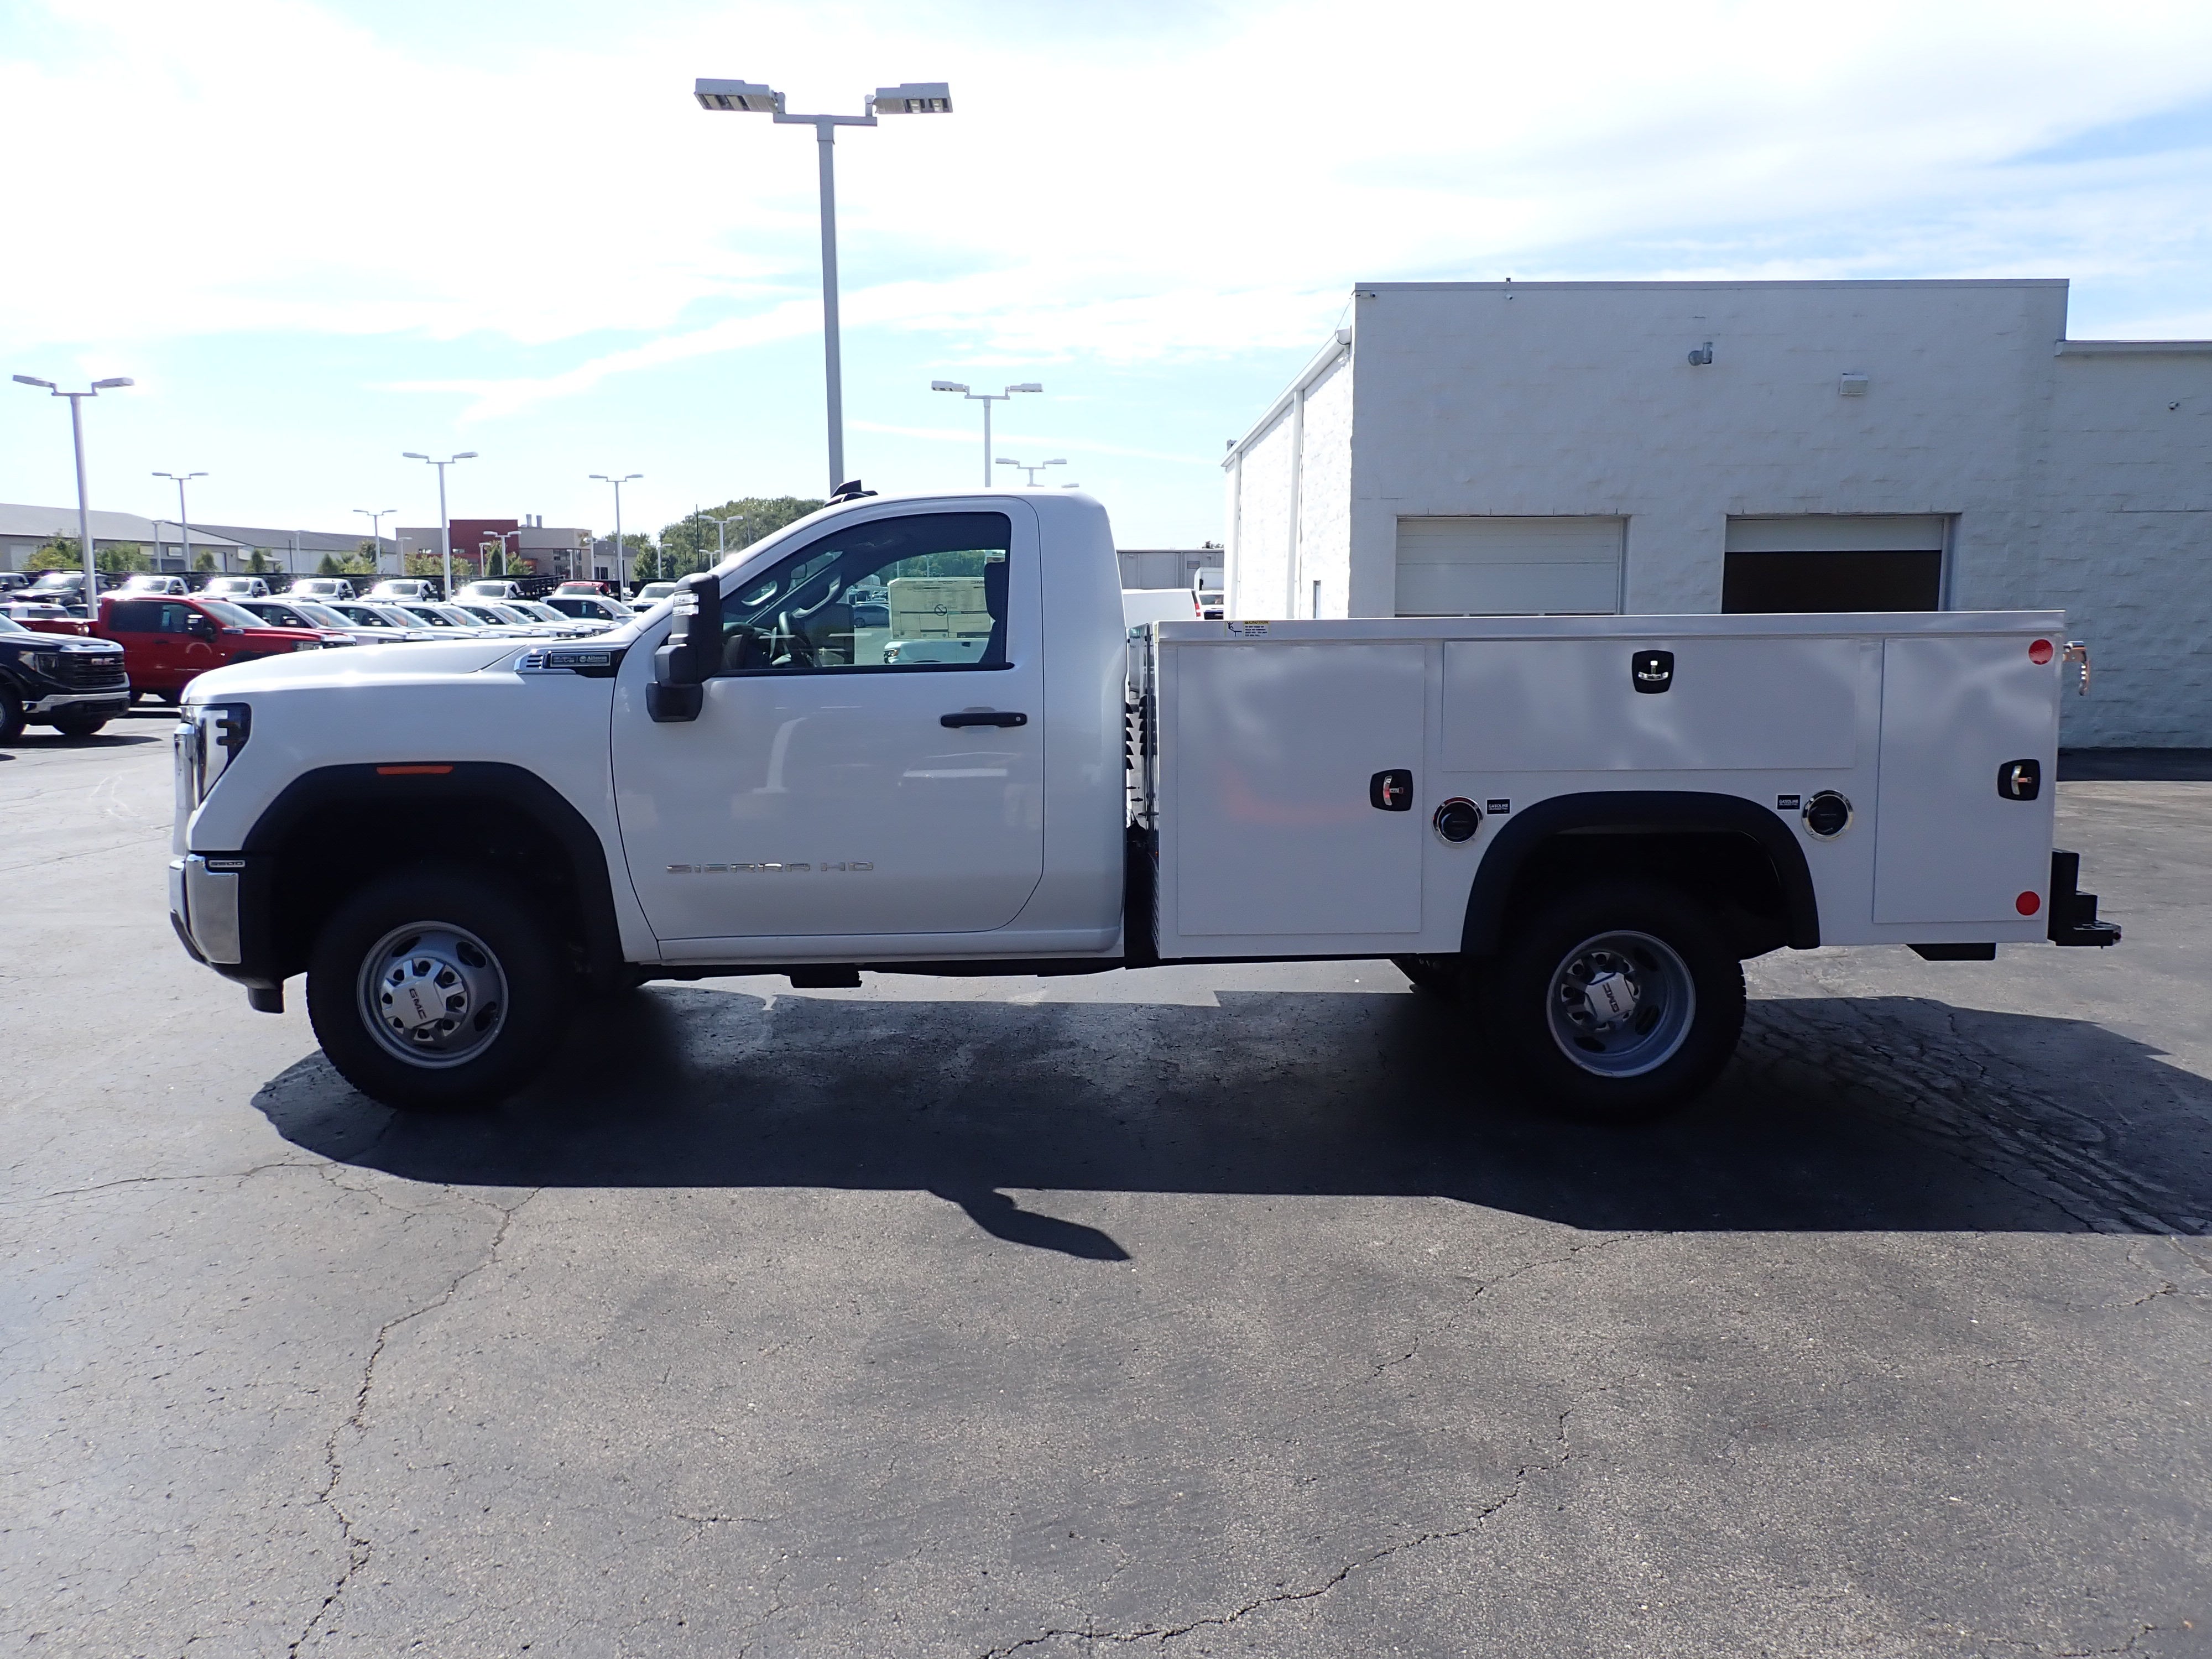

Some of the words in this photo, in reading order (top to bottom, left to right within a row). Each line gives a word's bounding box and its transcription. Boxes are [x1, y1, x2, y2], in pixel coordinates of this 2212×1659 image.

[666, 862, 811, 874] SIERRA
[820, 862, 874, 872] HD
[409, 988, 427, 1020] GMC
[1603, 982, 1620, 1013] GMC
